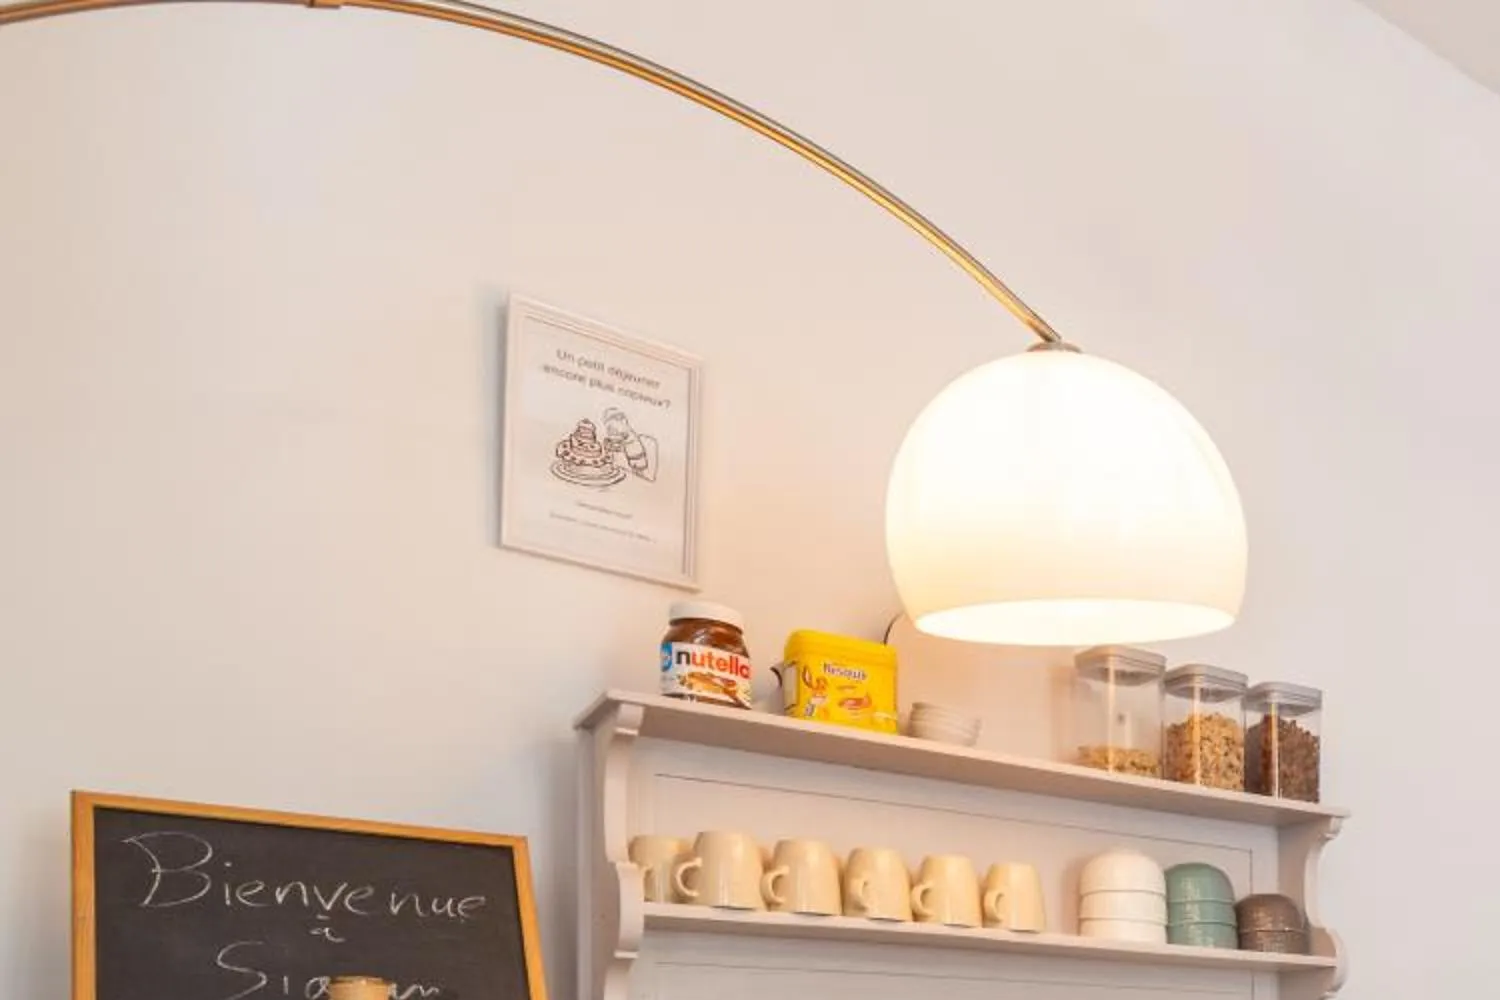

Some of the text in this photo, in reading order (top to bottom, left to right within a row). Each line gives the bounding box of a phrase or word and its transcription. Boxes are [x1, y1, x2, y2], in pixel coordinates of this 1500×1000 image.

[556, 349, 575, 361] Un
[542, 364, 586, 384] encore
[588, 378, 615, 393] plus
[676, 650, 752, 680] nutella
[121, 830, 486, 919] Bienvenue
